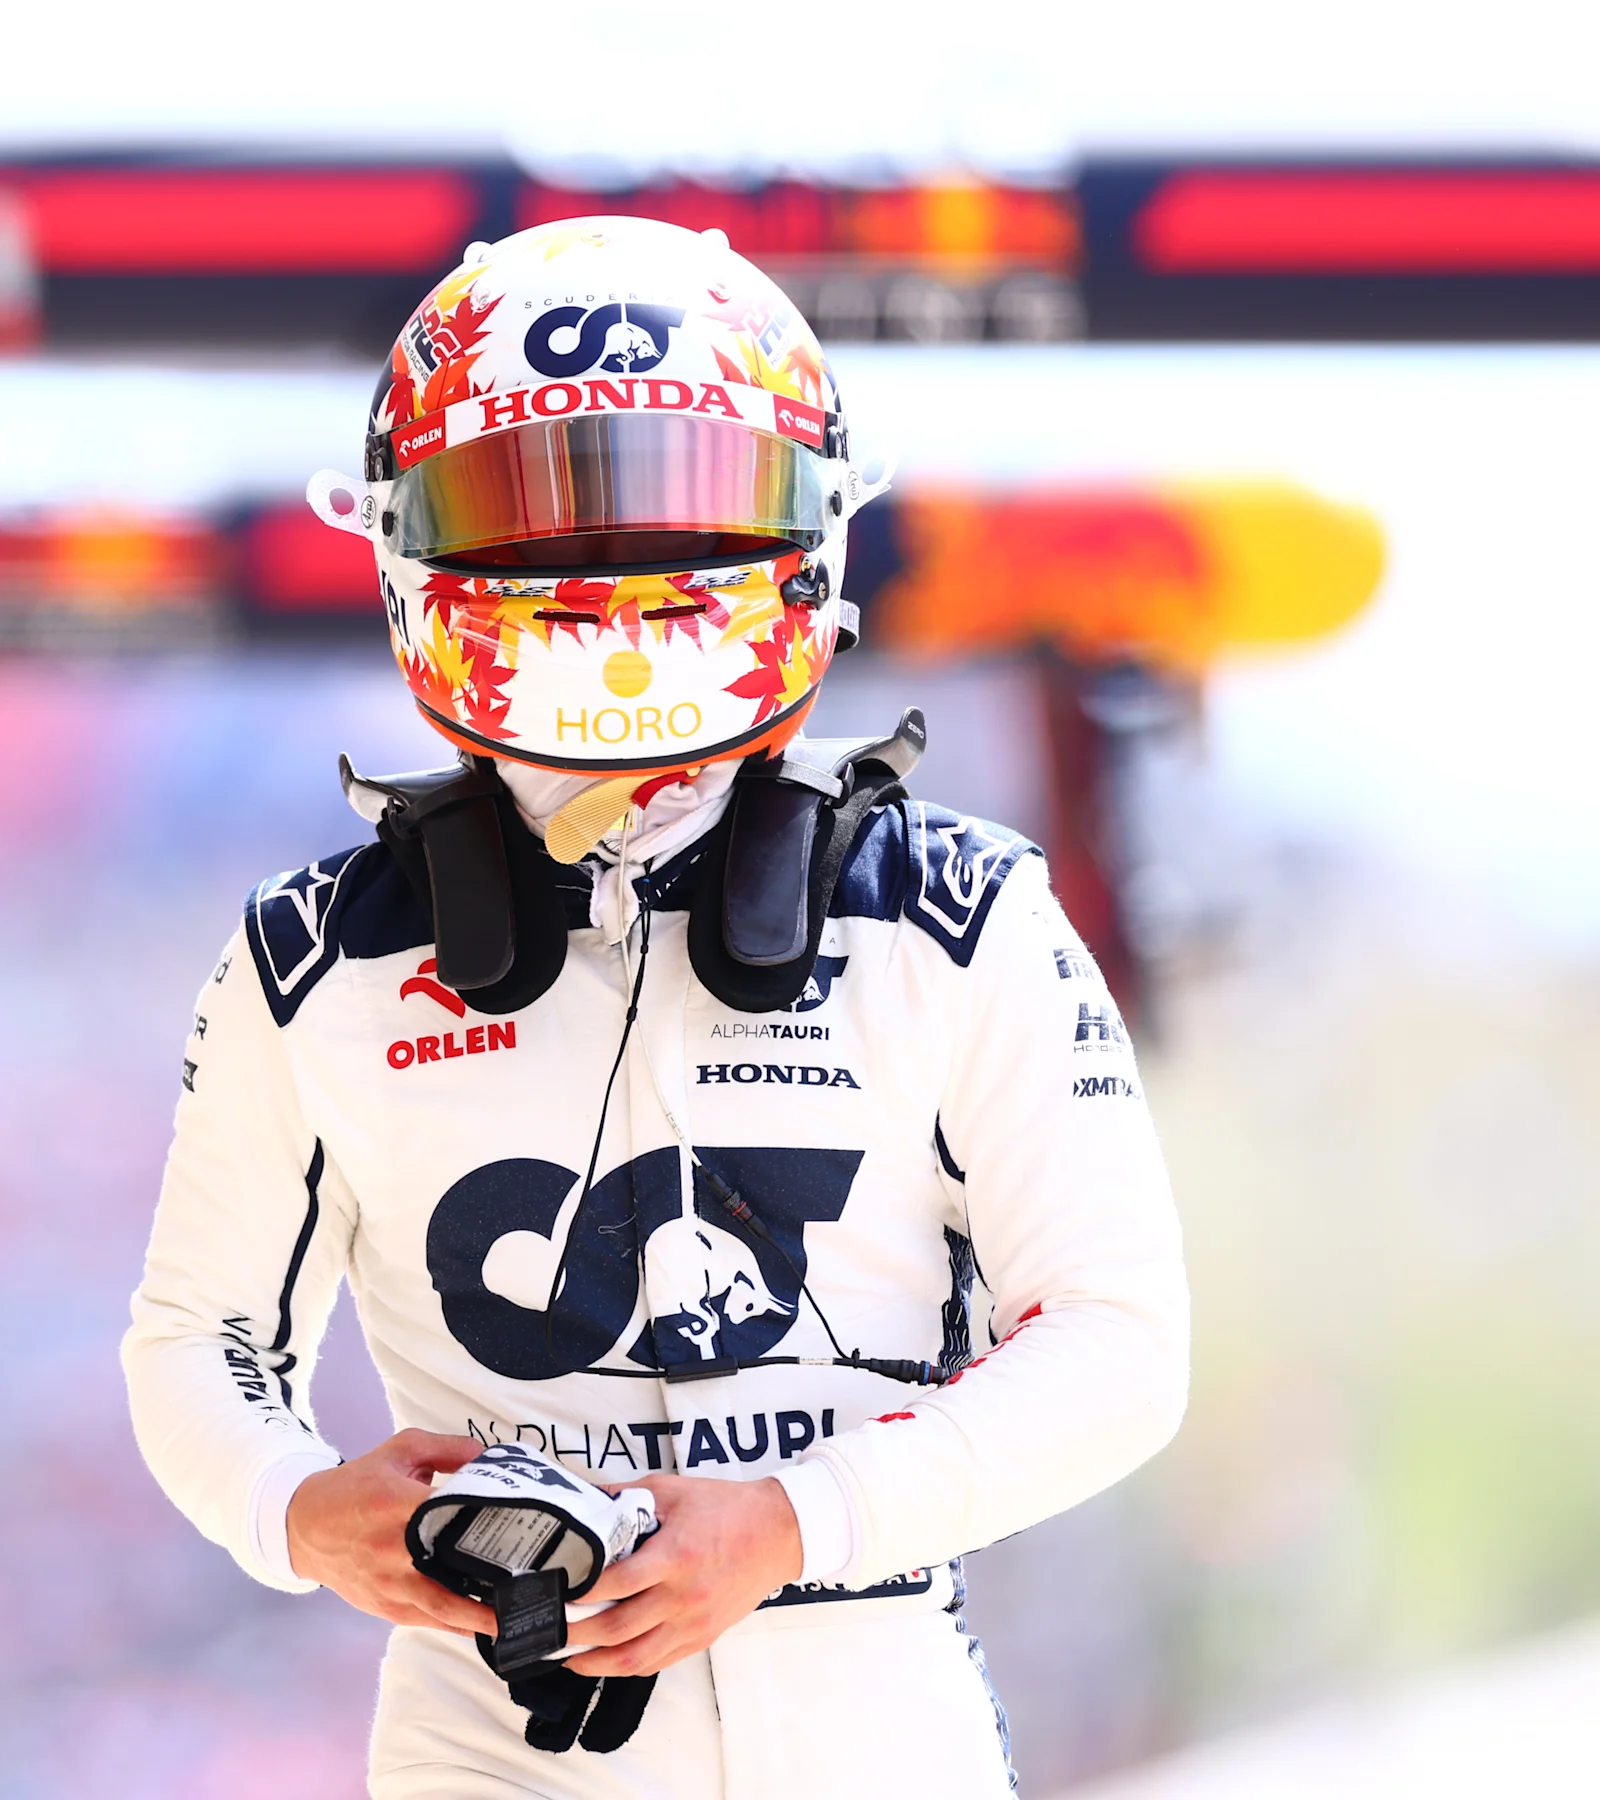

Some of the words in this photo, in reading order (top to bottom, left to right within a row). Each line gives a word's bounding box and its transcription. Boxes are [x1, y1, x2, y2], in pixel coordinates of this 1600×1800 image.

[524, 292, 674, 309] SCUDERI
[480, 379, 744, 431] HONDA
[795, 414, 821, 436] ORLEN
[411, 427, 442, 451] ORLEN
[362, 499, 374, 523] Arai
[557, 702, 702, 743] HORO
[711, 1024, 830, 1041] ALPHATAURI
[387, 1021, 517, 1070] ORLEN
[696, 1063, 862, 1090] HONDA
